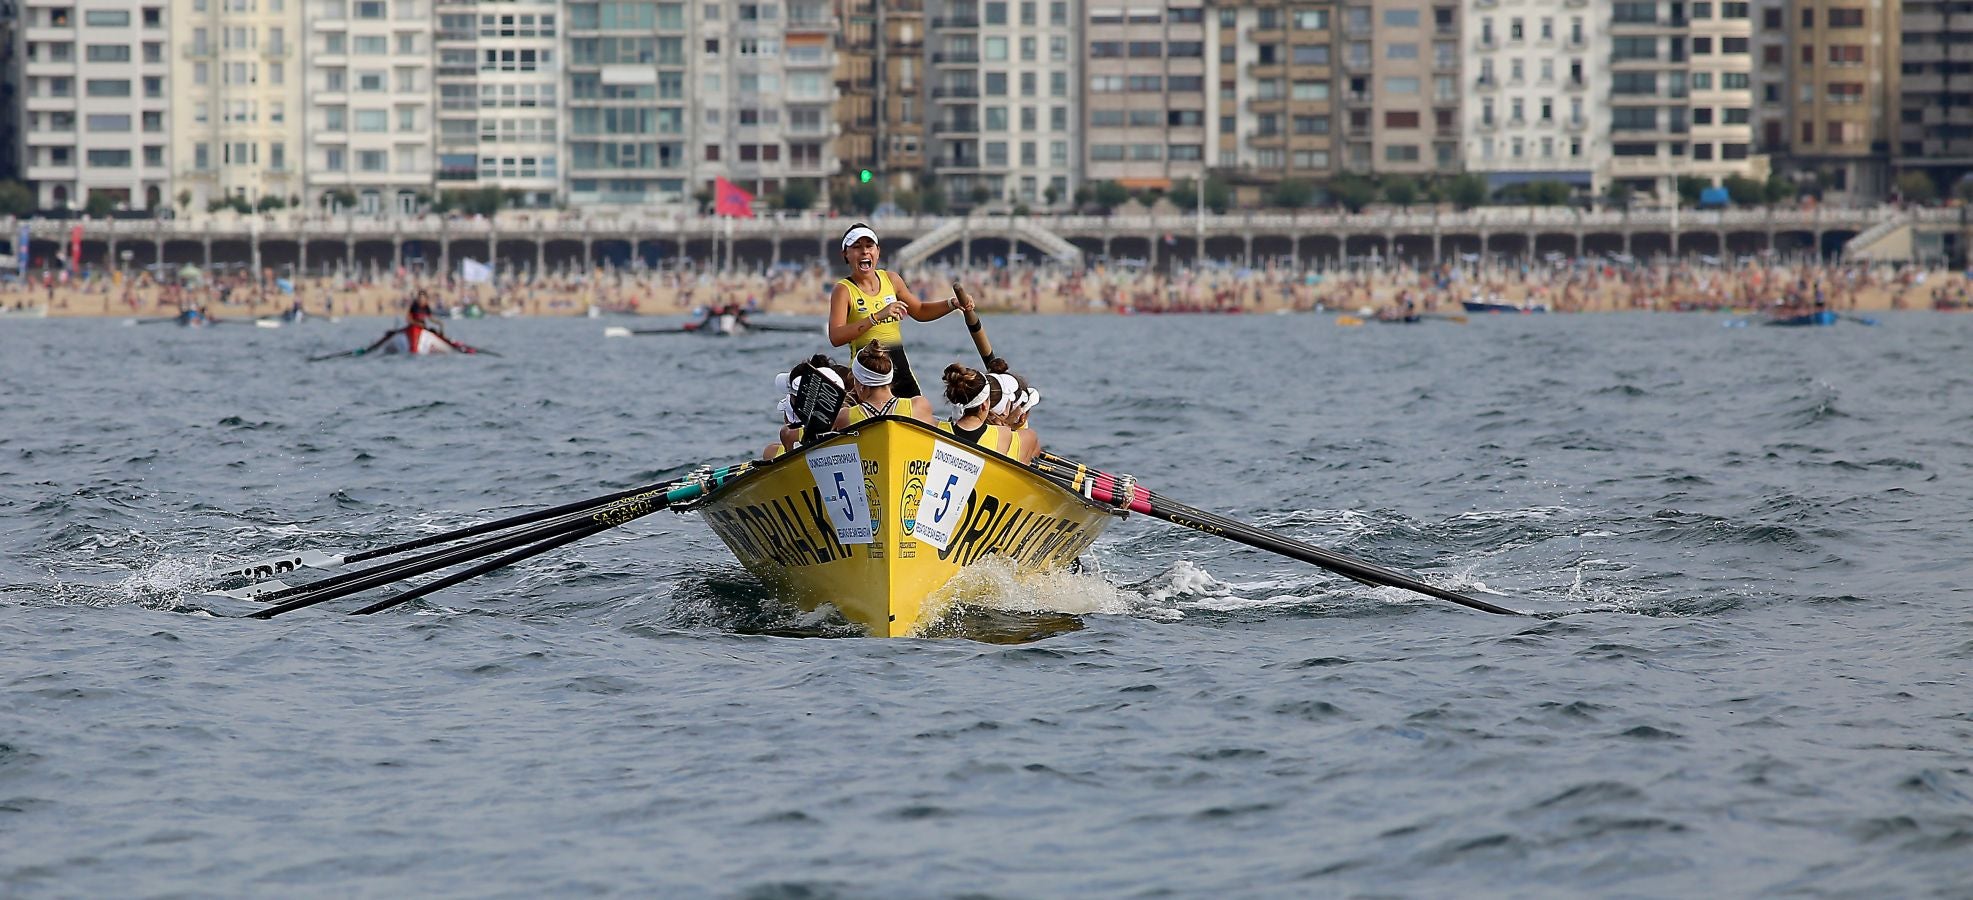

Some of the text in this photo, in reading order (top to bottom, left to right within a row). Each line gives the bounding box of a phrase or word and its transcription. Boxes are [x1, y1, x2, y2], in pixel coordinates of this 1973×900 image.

[817, 383, 839, 412] ORIO
[834, 472, 854, 521] 5
[934, 474, 958, 523] 5
[735, 486, 852, 568] ORIALK
